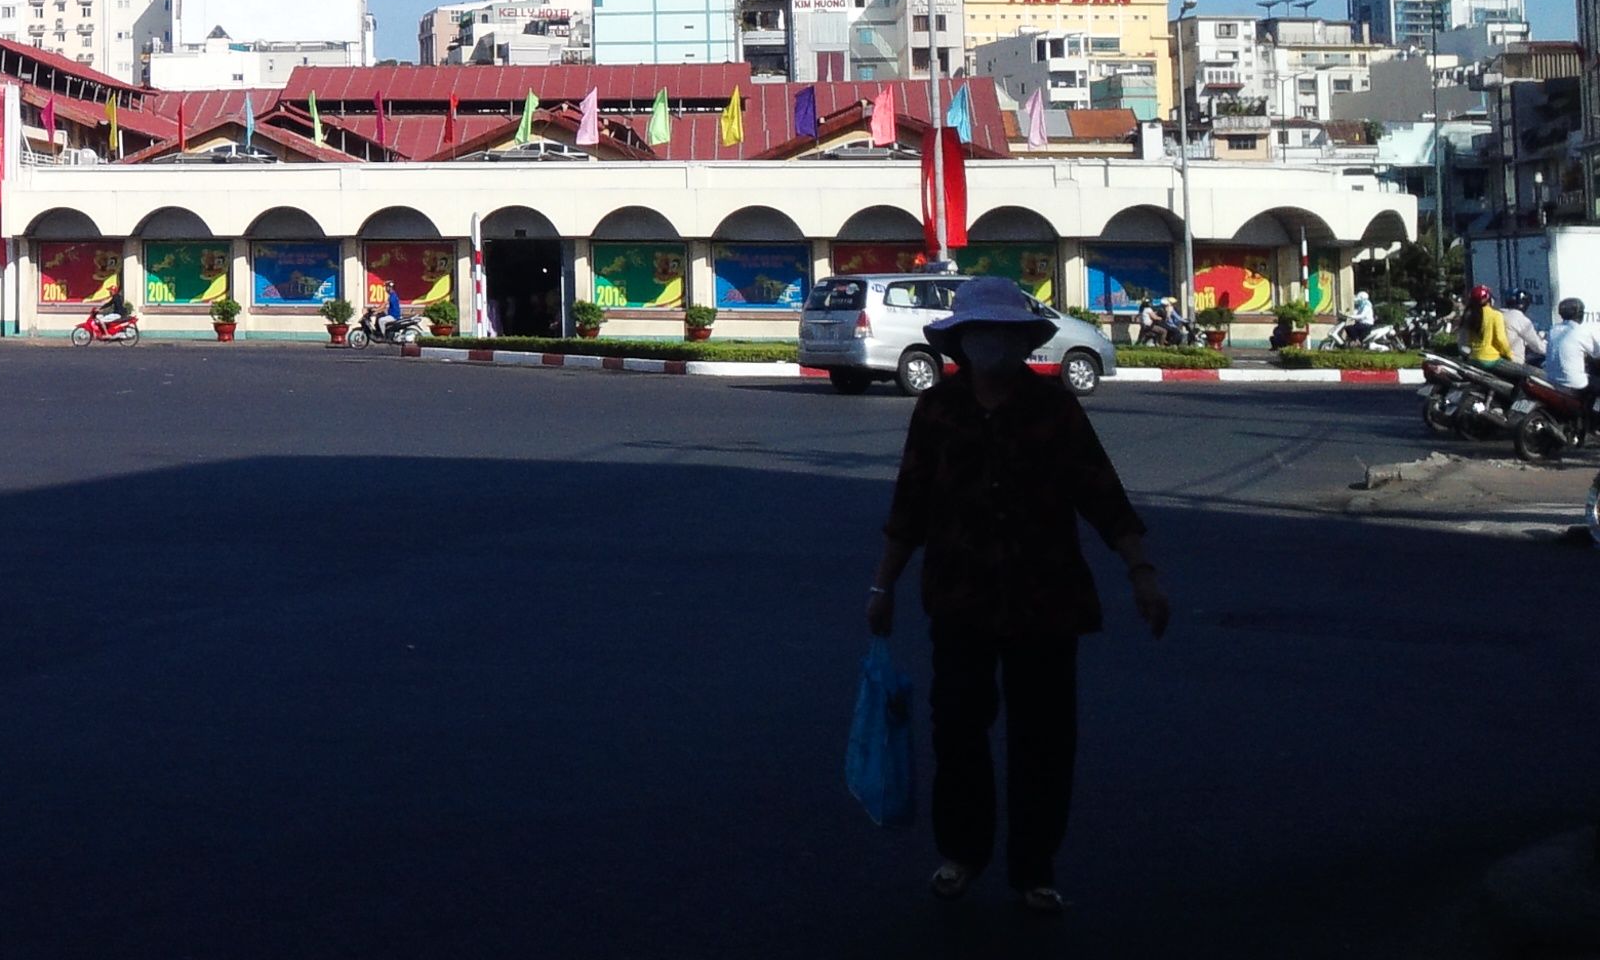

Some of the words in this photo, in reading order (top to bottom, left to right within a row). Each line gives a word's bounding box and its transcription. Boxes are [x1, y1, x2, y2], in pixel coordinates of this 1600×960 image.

[499, 7, 534, 17] KELLY
[538, 8, 572, 18] HOTEL
[794, 0, 811, 8] KIM
[43, 283, 67, 301] 2013
[148, 281, 176, 302] 2013
[596, 285, 627, 307] 2013
[1193, 291, 1215, 311] 2013
